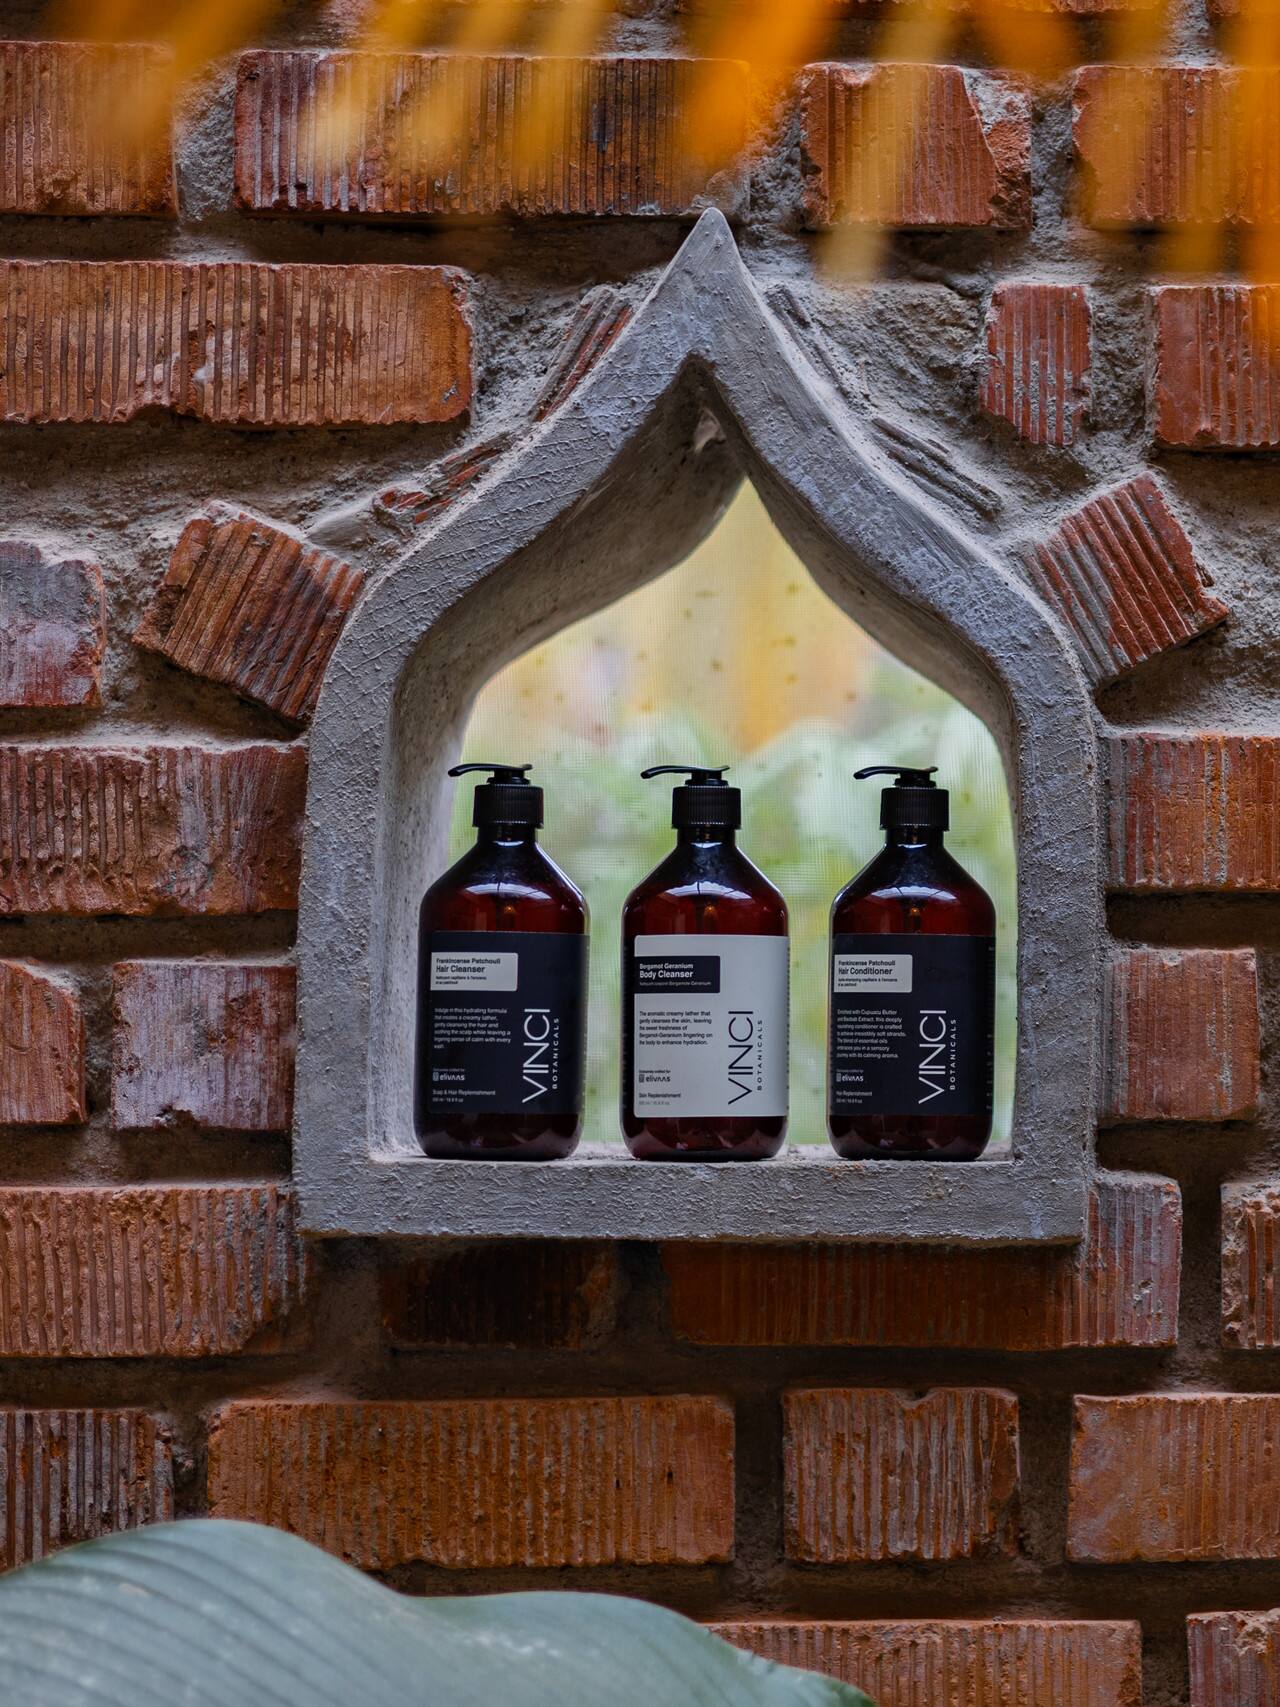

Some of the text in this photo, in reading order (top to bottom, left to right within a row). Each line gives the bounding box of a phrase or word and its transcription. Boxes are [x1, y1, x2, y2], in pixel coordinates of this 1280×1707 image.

[436, 965, 486, 973] Hair Cleanser
[640, 970, 694, 980] Body Cleanser
[838, 967, 893, 975] Hair Conditioner
[522, 1008, 551, 1103] VINCI
[552, 1017, 560, 1090] BOTANICALS
[728, 1010, 754, 1104] VINCI
[918, 1010, 947, 1104] VINCI
